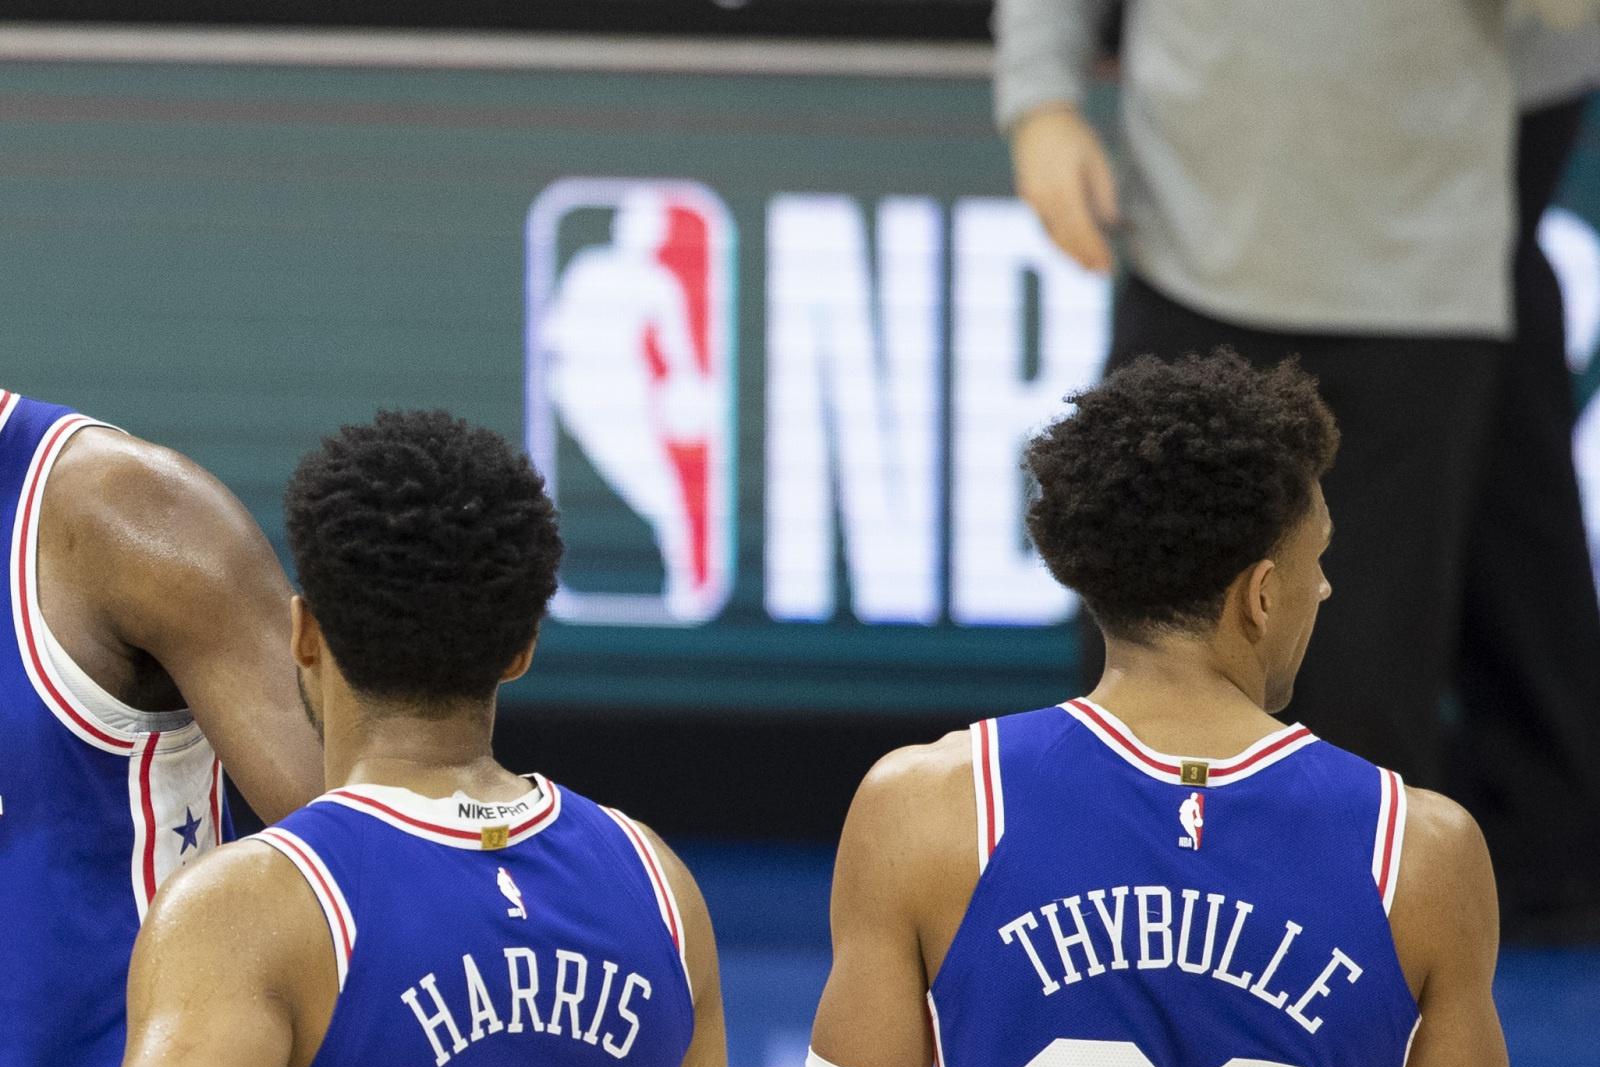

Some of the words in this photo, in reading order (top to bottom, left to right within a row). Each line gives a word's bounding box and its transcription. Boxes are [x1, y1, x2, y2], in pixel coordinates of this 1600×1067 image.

[764, 193, 1112, 626] NB
[458, 803, 496, 820] NIKE
[400, 947, 652, 1067] HARRIS
[998, 886, 1363, 1035] THYBULLE
